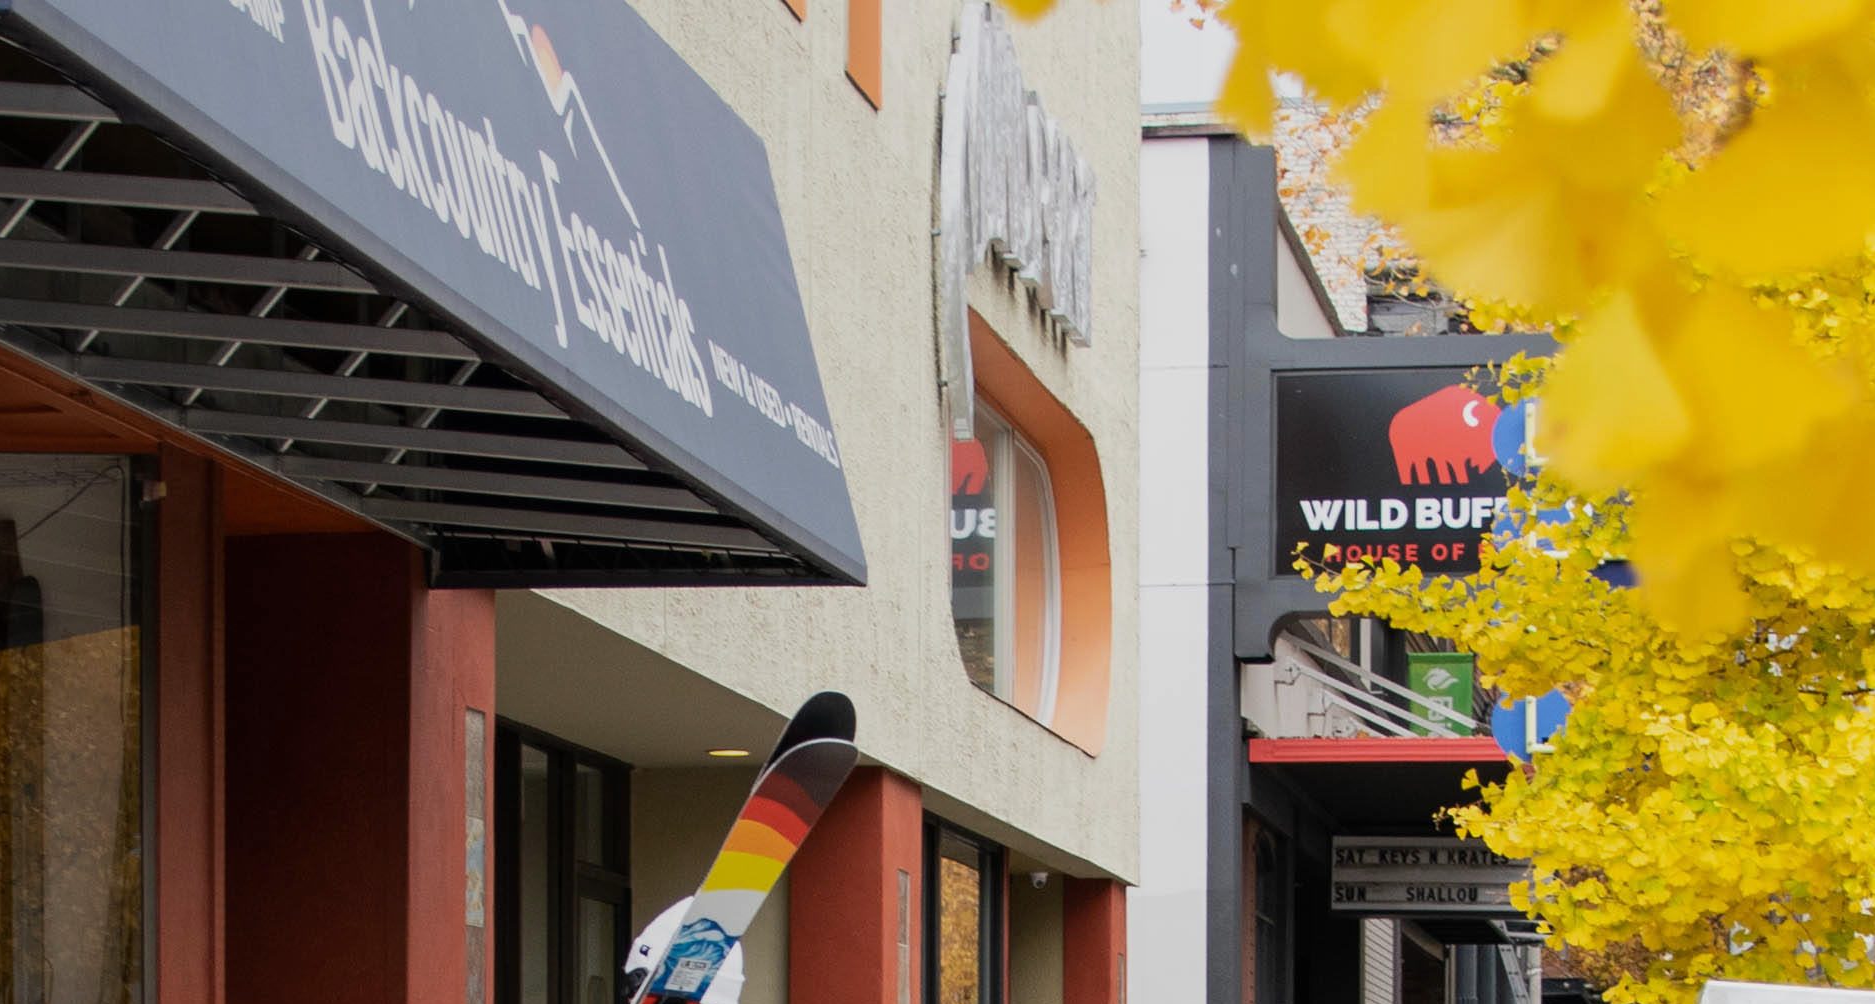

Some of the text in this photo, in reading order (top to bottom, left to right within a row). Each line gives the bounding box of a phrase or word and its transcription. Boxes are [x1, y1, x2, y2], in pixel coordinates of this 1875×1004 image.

[302, 0, 568, 348] Backcountry
[538, 149, 714, 418] Essentials
[750, 369, 788, 428] USED
[1299, 498, 1409, 530] WILD
[1431, 542, 1466, 562] OF
[1335, 847, 1366, 865] SAT
[1378, 847, 1421, 865] KEYS
[1447, 847, 1510, 865] KRATES
[1335, 886, 1478, 902] SUN SHALLOU
